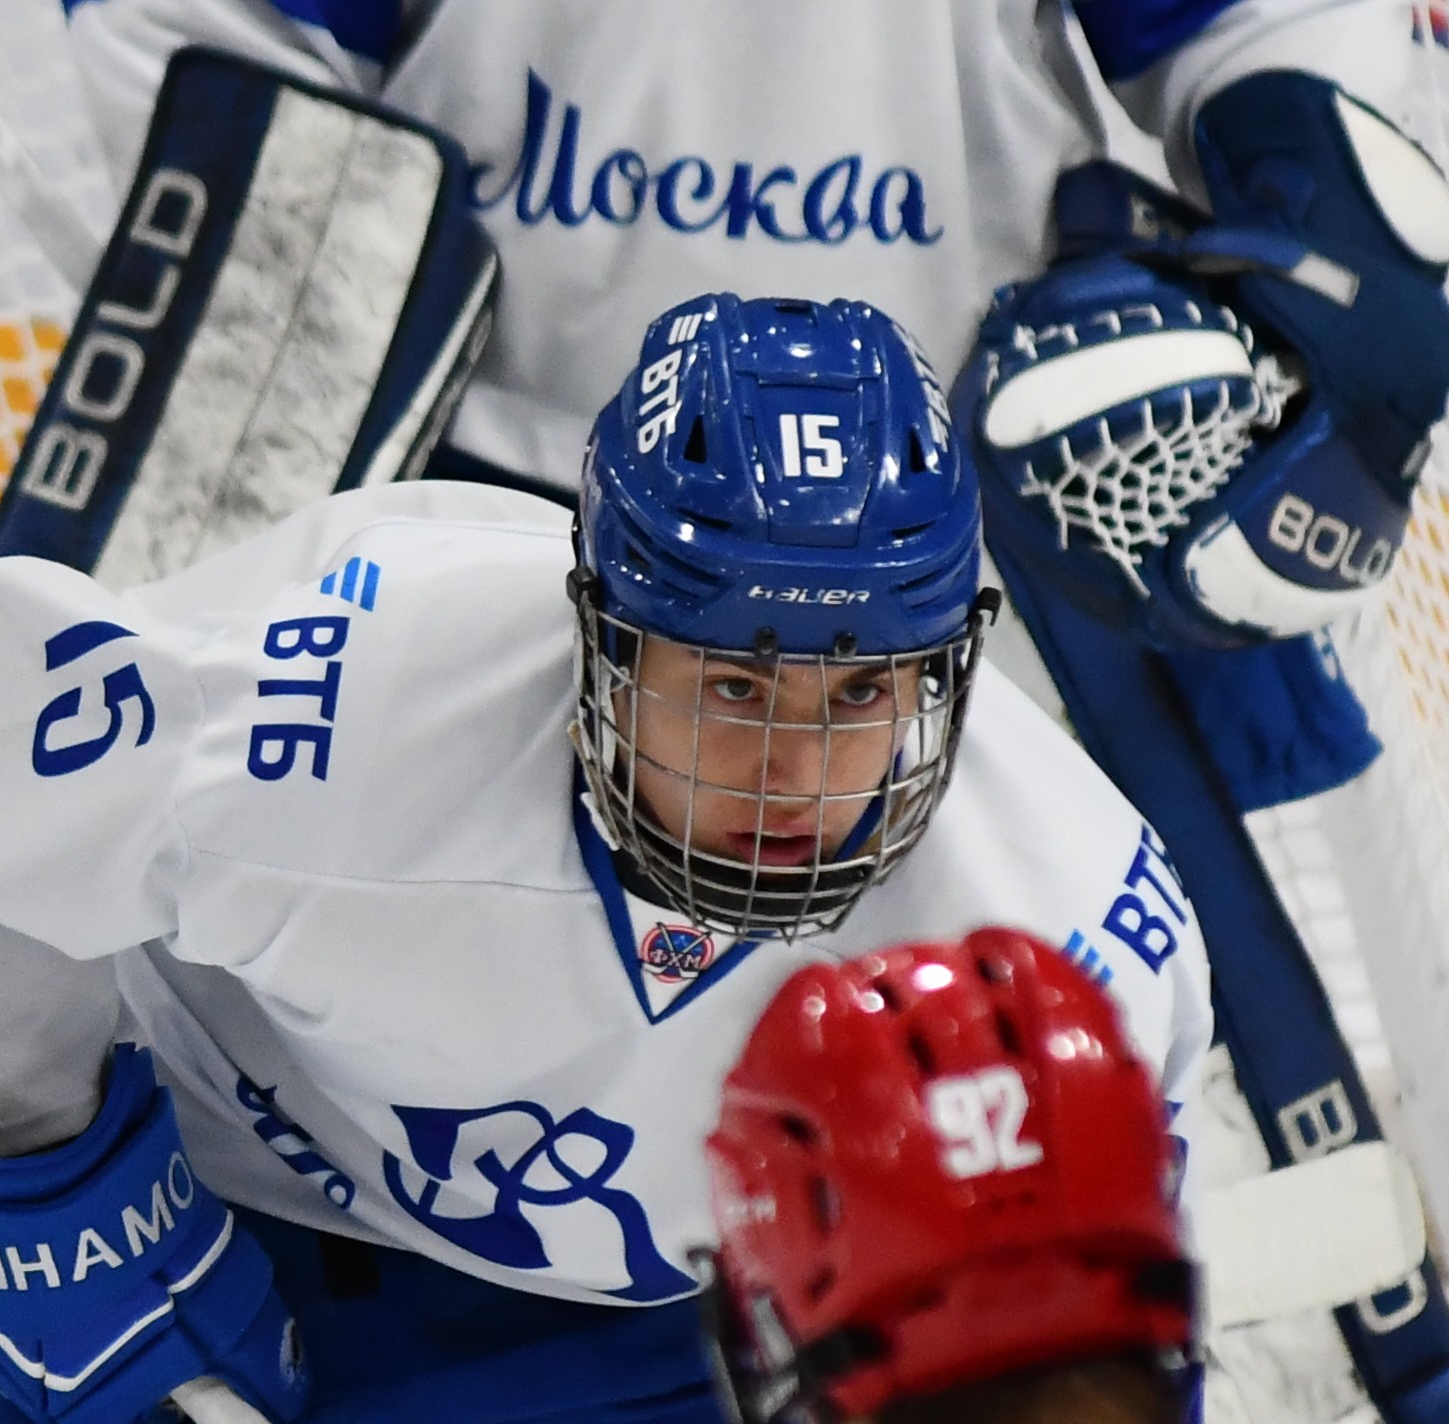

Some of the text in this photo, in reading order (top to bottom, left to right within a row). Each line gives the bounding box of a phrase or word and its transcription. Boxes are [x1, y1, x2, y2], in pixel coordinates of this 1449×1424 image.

[463, 67, 943, 245] Москва
[21, 167, 209, 512] BOLD
[637, 348, 683, 455] ВТБ
[780, 413, 844, 478] 15
[246, 615, 351, 782] ВТБ
[926, 1066, 1045, 1181] 92
